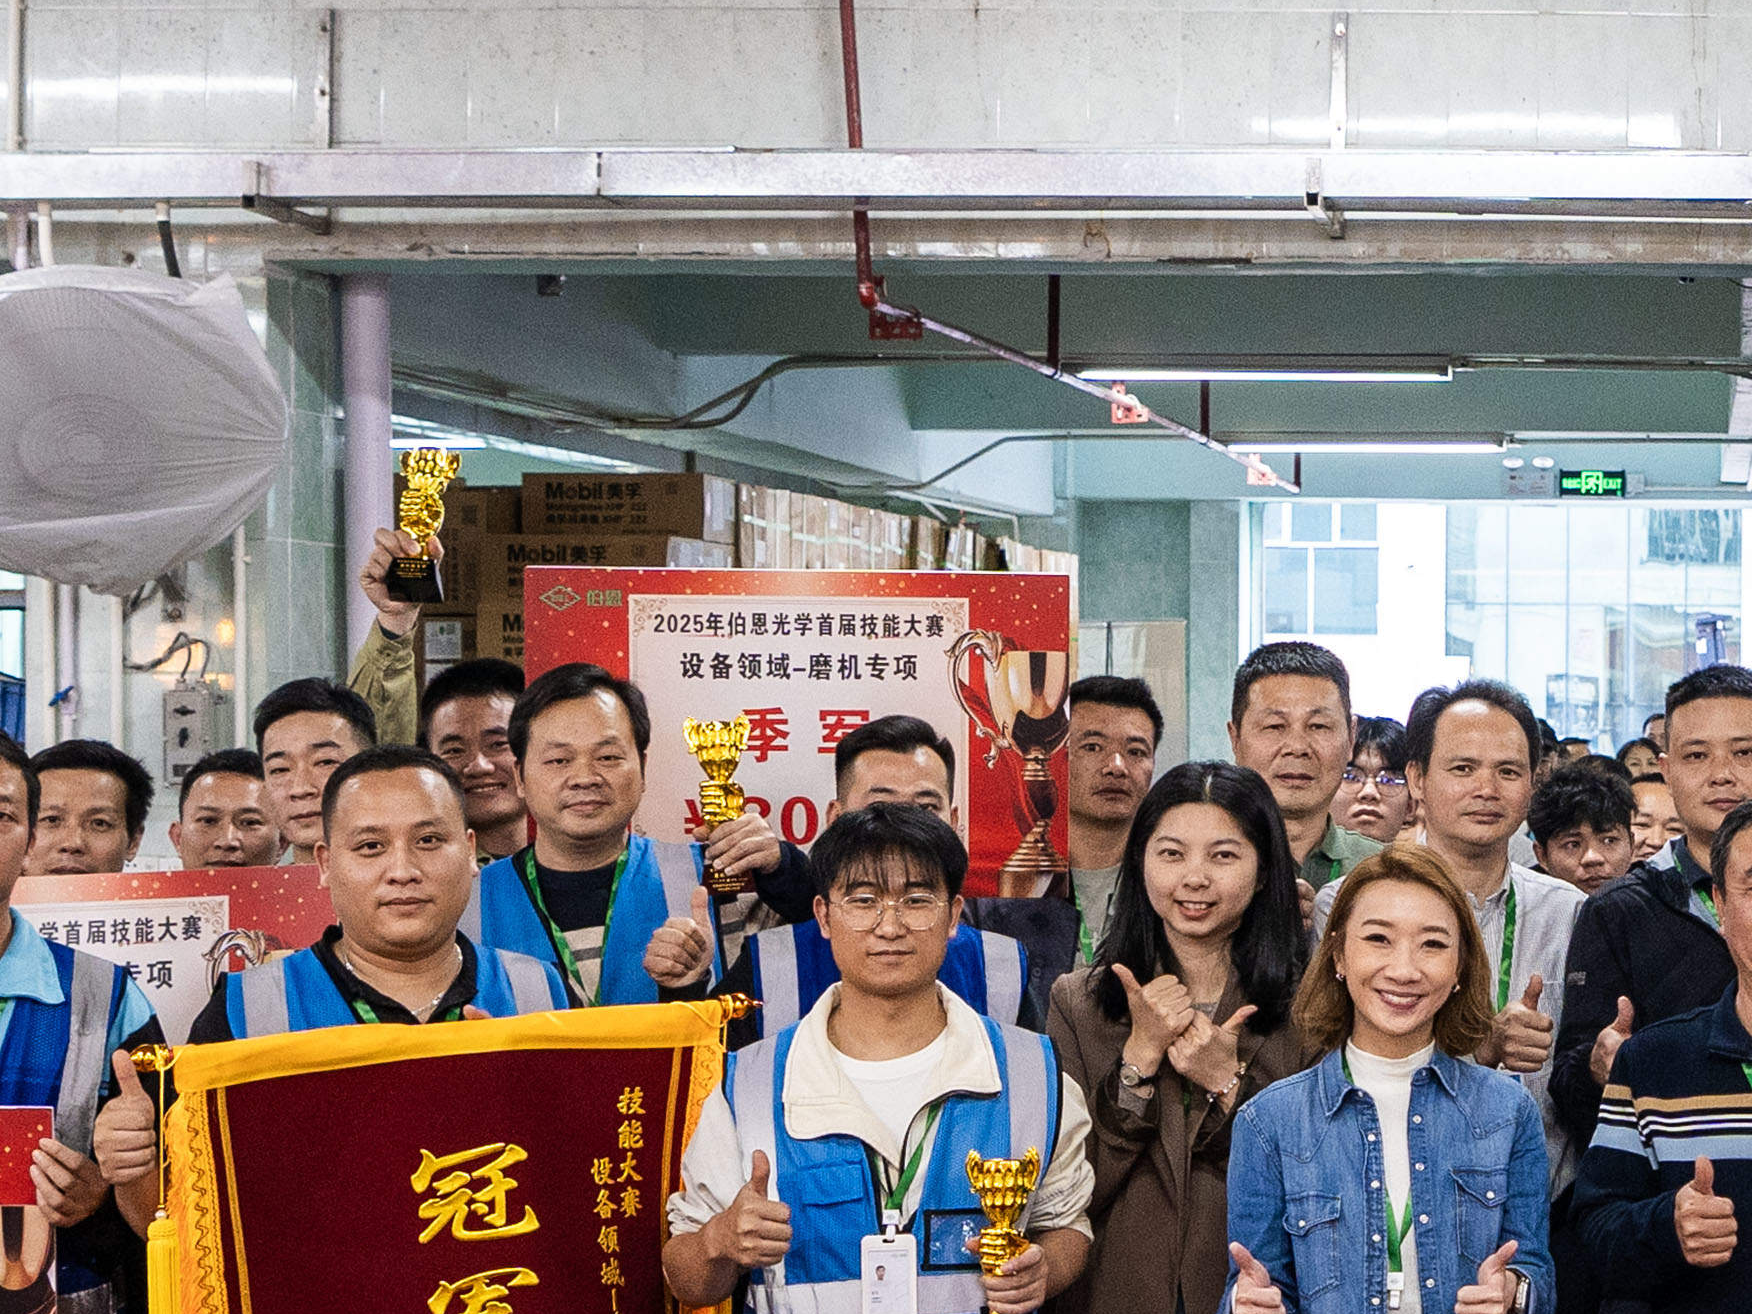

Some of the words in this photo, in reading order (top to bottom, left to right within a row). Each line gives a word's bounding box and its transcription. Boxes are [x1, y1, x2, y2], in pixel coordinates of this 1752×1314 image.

[545, 482, 602, 500] Mobil
[507, 544, 566, 562] Mobil
[586, 589, 623, 606] 伯恩
[653, 611, 945, 639] 2025年伯恩光学首届技能大赛
[680, 652, 919, 681] 设备领域-磨机专项
[615, 1085, 647, 1219] 技能大赛
